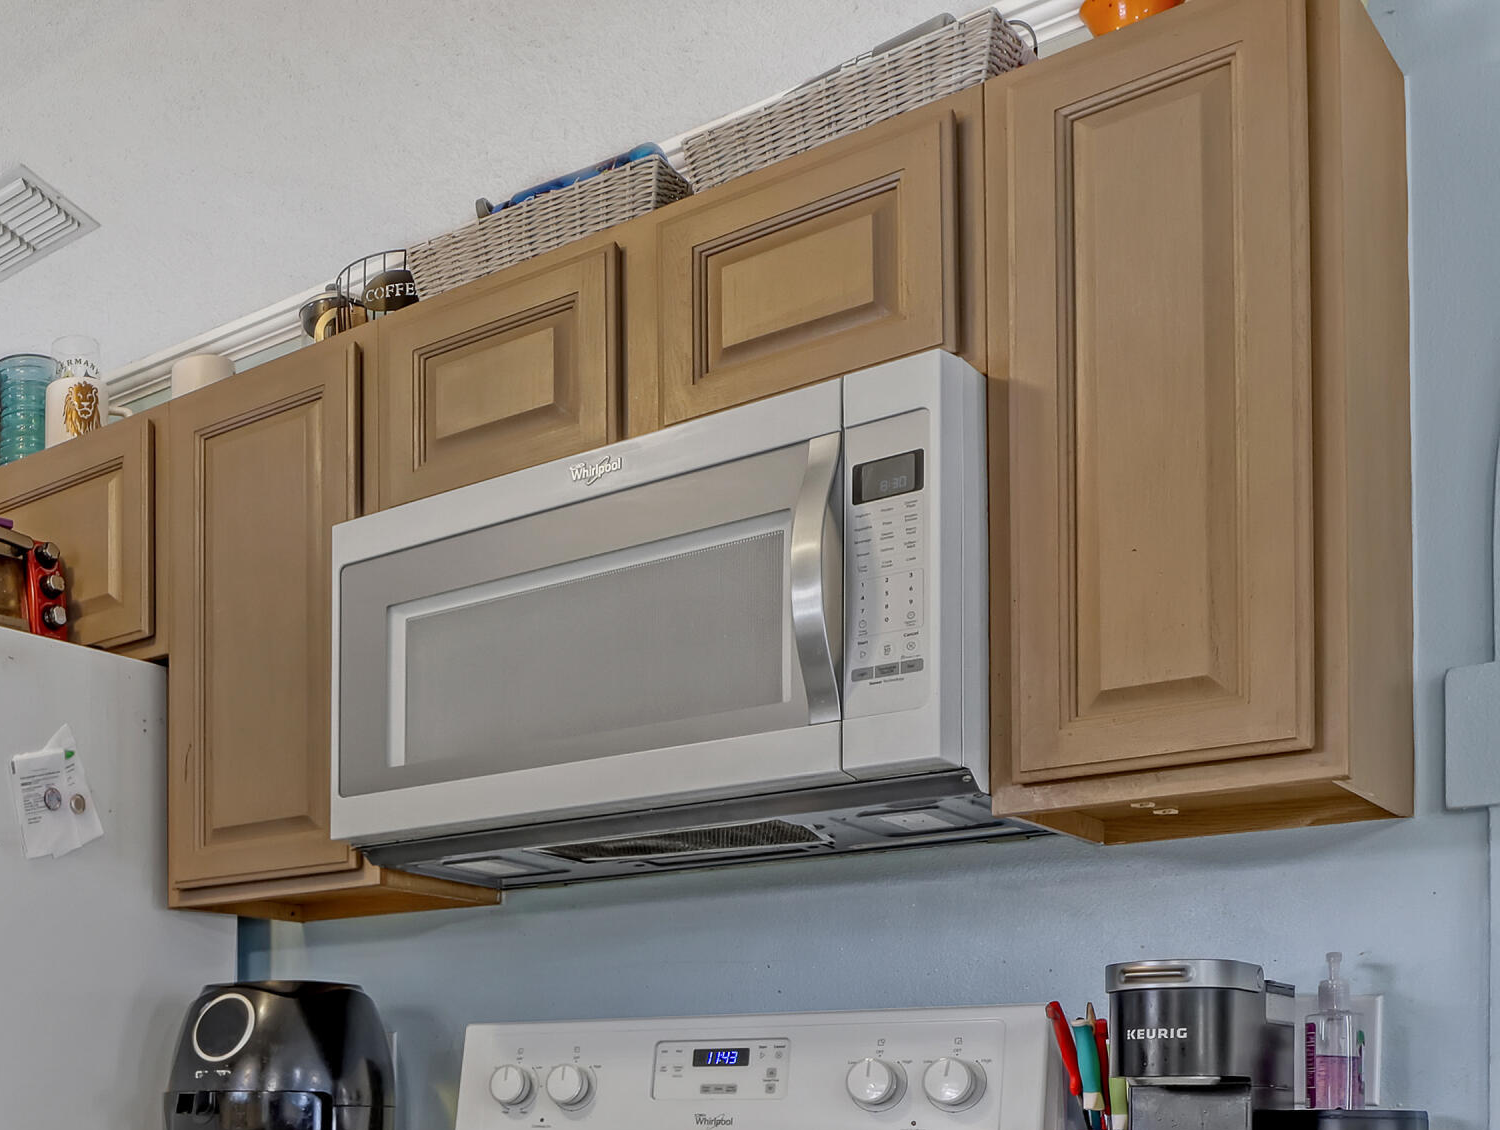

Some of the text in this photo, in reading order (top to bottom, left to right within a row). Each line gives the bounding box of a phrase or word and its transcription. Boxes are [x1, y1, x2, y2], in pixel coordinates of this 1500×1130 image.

[365, 282, 417, 302] COFFE
[569, 456, 622, 486] Whirlpool
[1126, 1027, 1188, 1040] KEURIG
[707, 1051, 739, 1065] 11:43
[695, 1114, 733, 1129] Whirlpool
